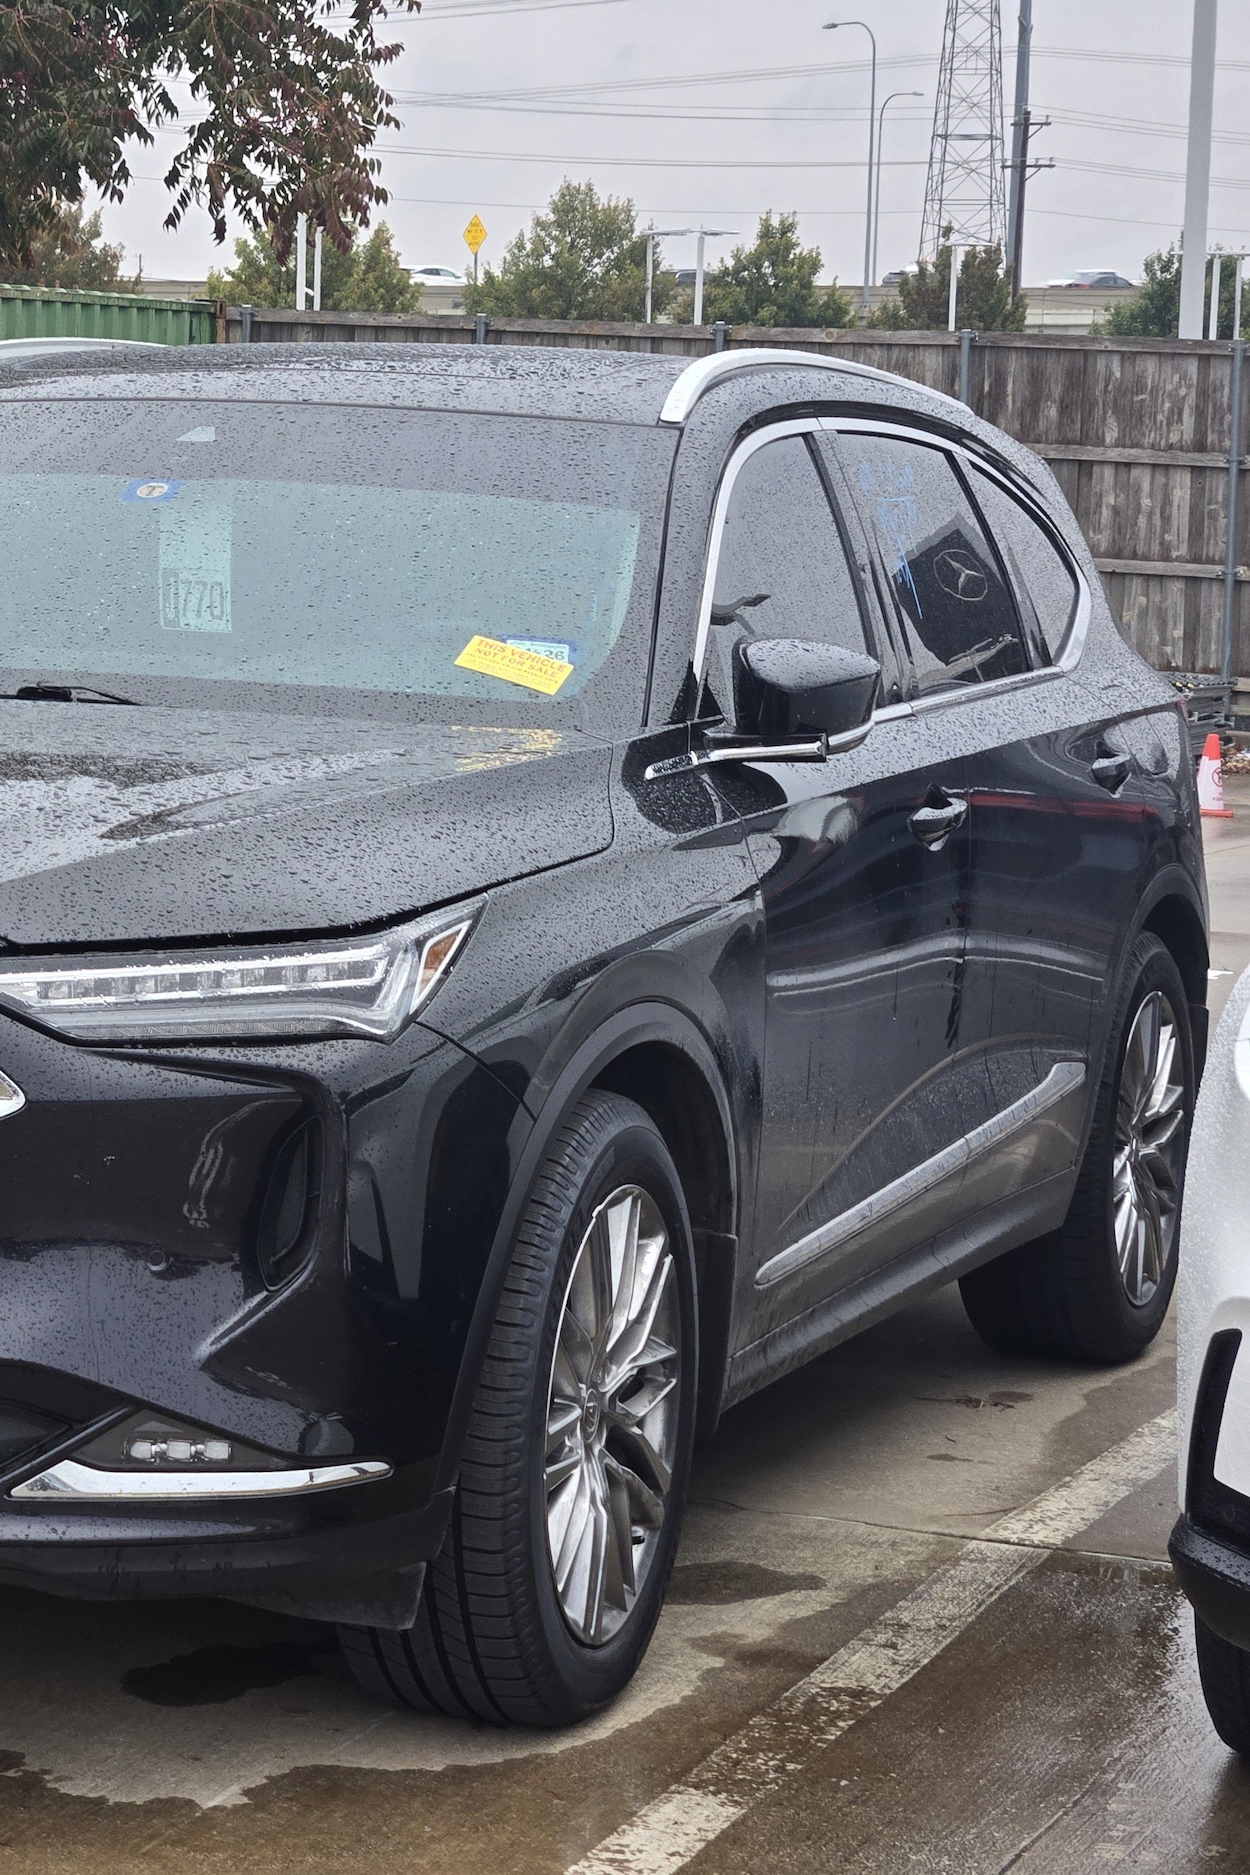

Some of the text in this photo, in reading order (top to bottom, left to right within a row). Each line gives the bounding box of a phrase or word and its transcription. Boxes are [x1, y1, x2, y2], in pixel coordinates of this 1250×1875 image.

[475, 647, 498, 658] NOT
[500, 654, 525, 667] FOR
[527, 664, 559, 678] SALE
[477, 639, 508, 654] THIS
[511, 647, 568, 673] VEHICLE
